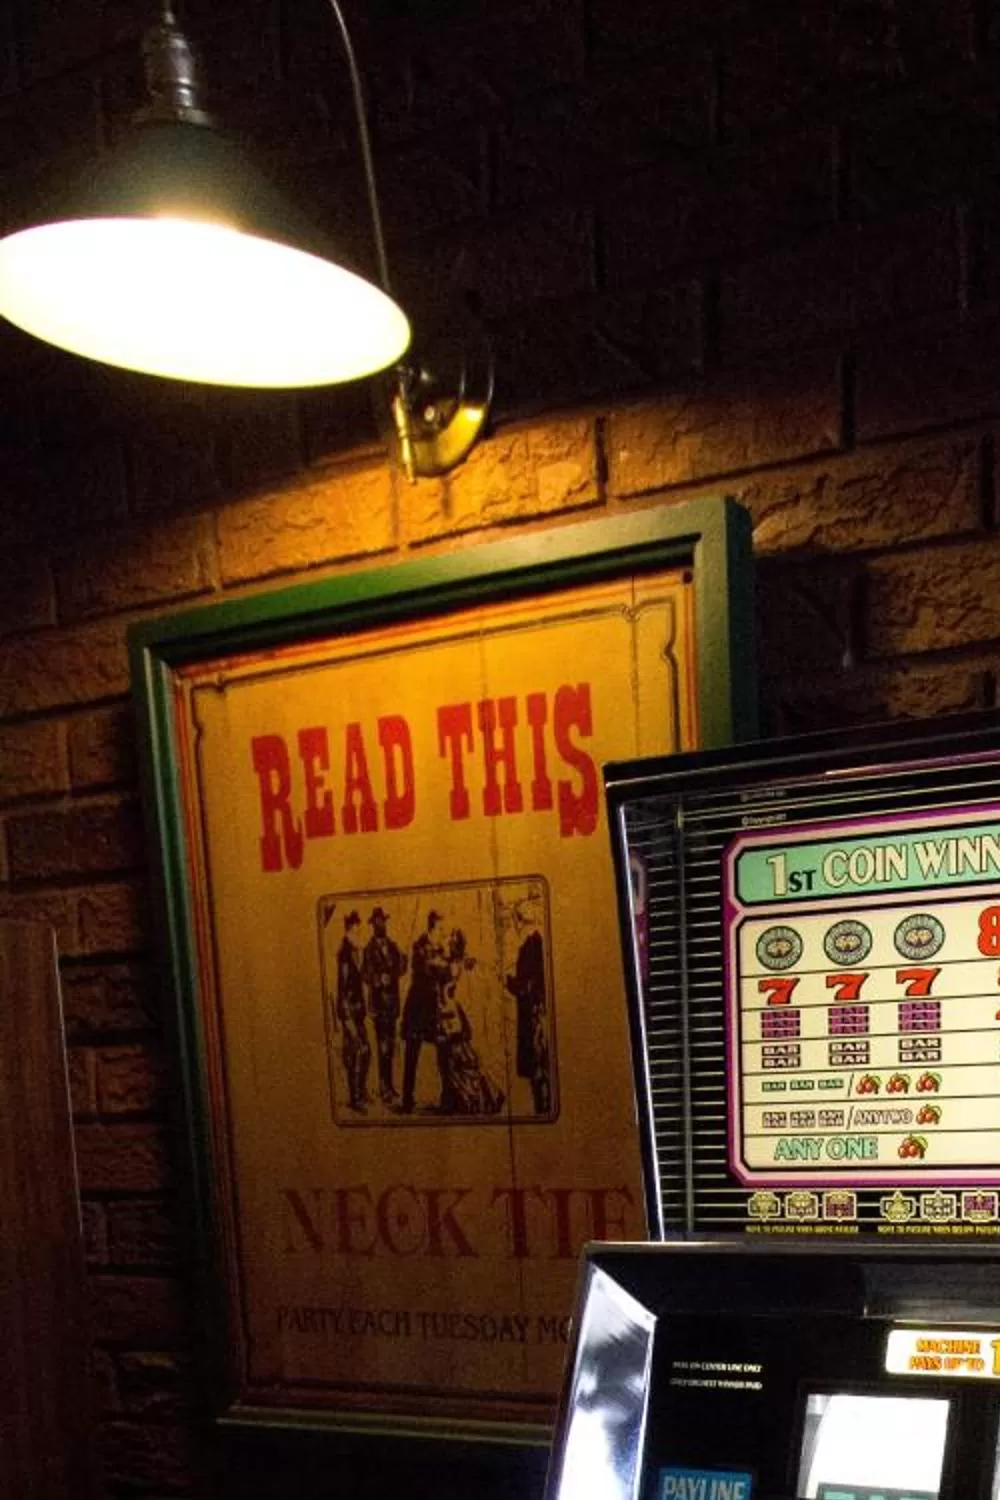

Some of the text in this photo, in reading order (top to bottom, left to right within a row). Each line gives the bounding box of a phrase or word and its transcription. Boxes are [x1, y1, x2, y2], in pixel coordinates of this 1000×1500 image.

[252, 682, 598, 873] READ THIS
[822, 844, 908, 888] COIN
[758, 977, 801, 1005] 7
[826, 972, 870, 1000] 7
[896, 968, 942, 997] 7
[764, 1039, 939, 1055] BAR BAR BAR
[764, 1052, 939, 1067] BAR BAR BAR
[774, 1137, 879, 1160] ANY ONE
[279, 1183, 478, 1258] NECK
[350, 1310, 409, 1338] EACH
[417, 1312, 529, 1343] TUESDAY
